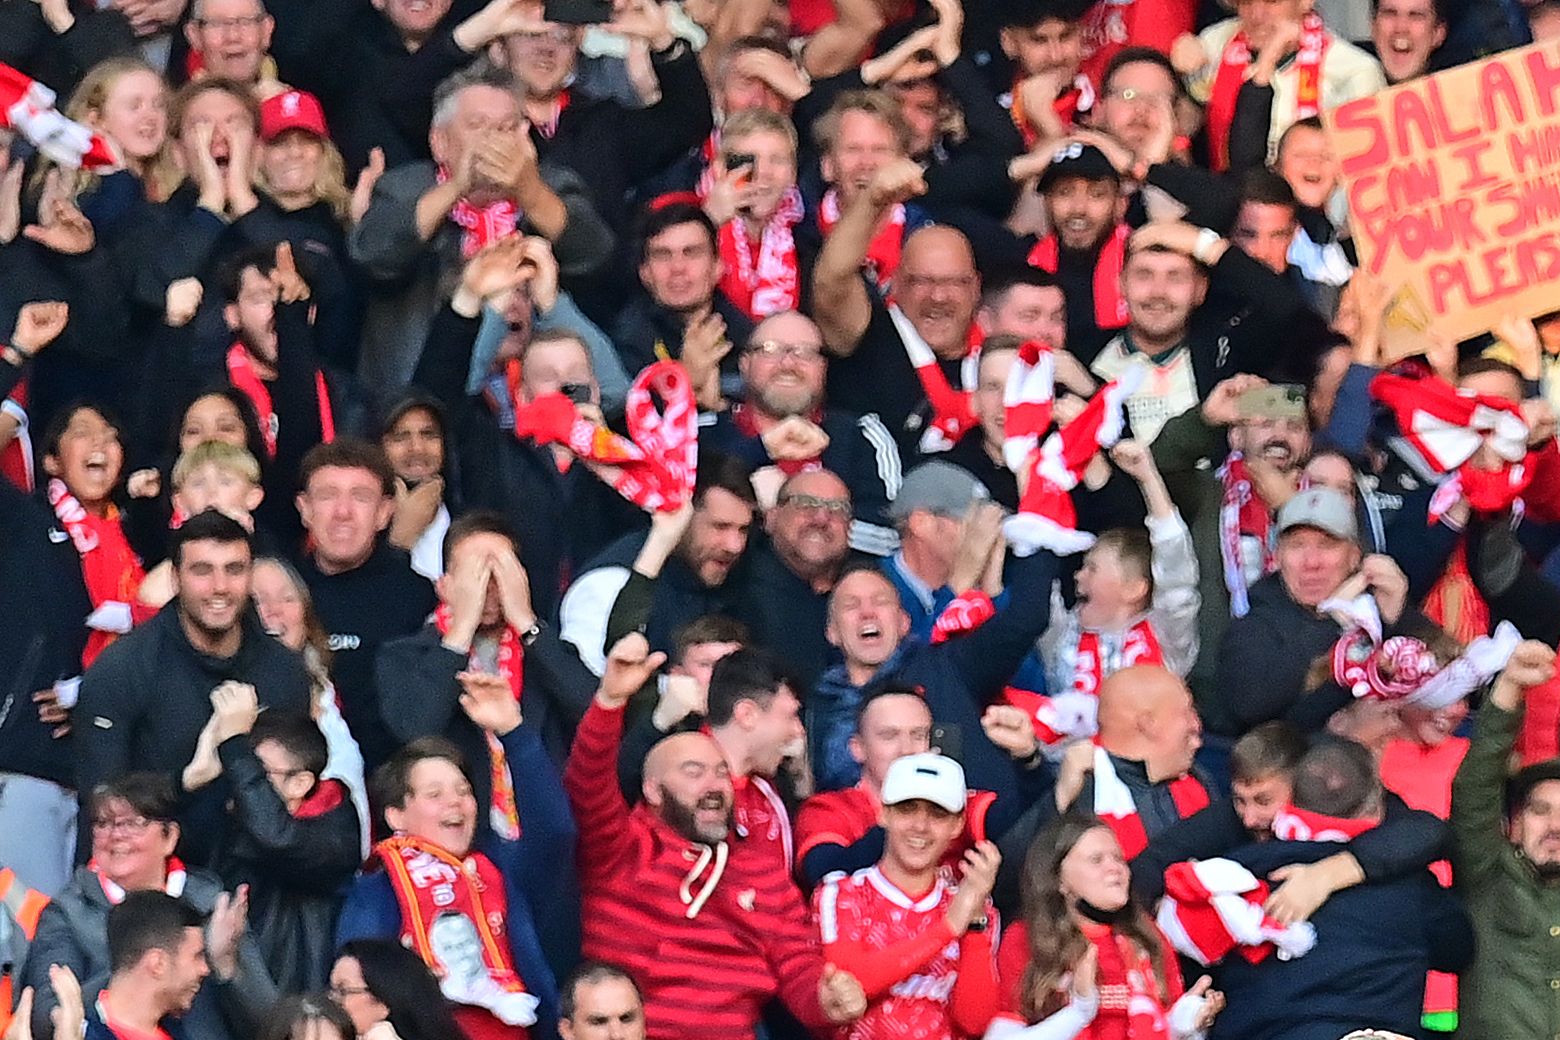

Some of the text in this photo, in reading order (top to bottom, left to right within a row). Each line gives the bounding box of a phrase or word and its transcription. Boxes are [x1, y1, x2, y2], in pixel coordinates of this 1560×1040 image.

[1350, 157, 1441, 221] CAN
[1452, 141, 1499, 191] I
[1364, 198, 1487, 276] YOUR
